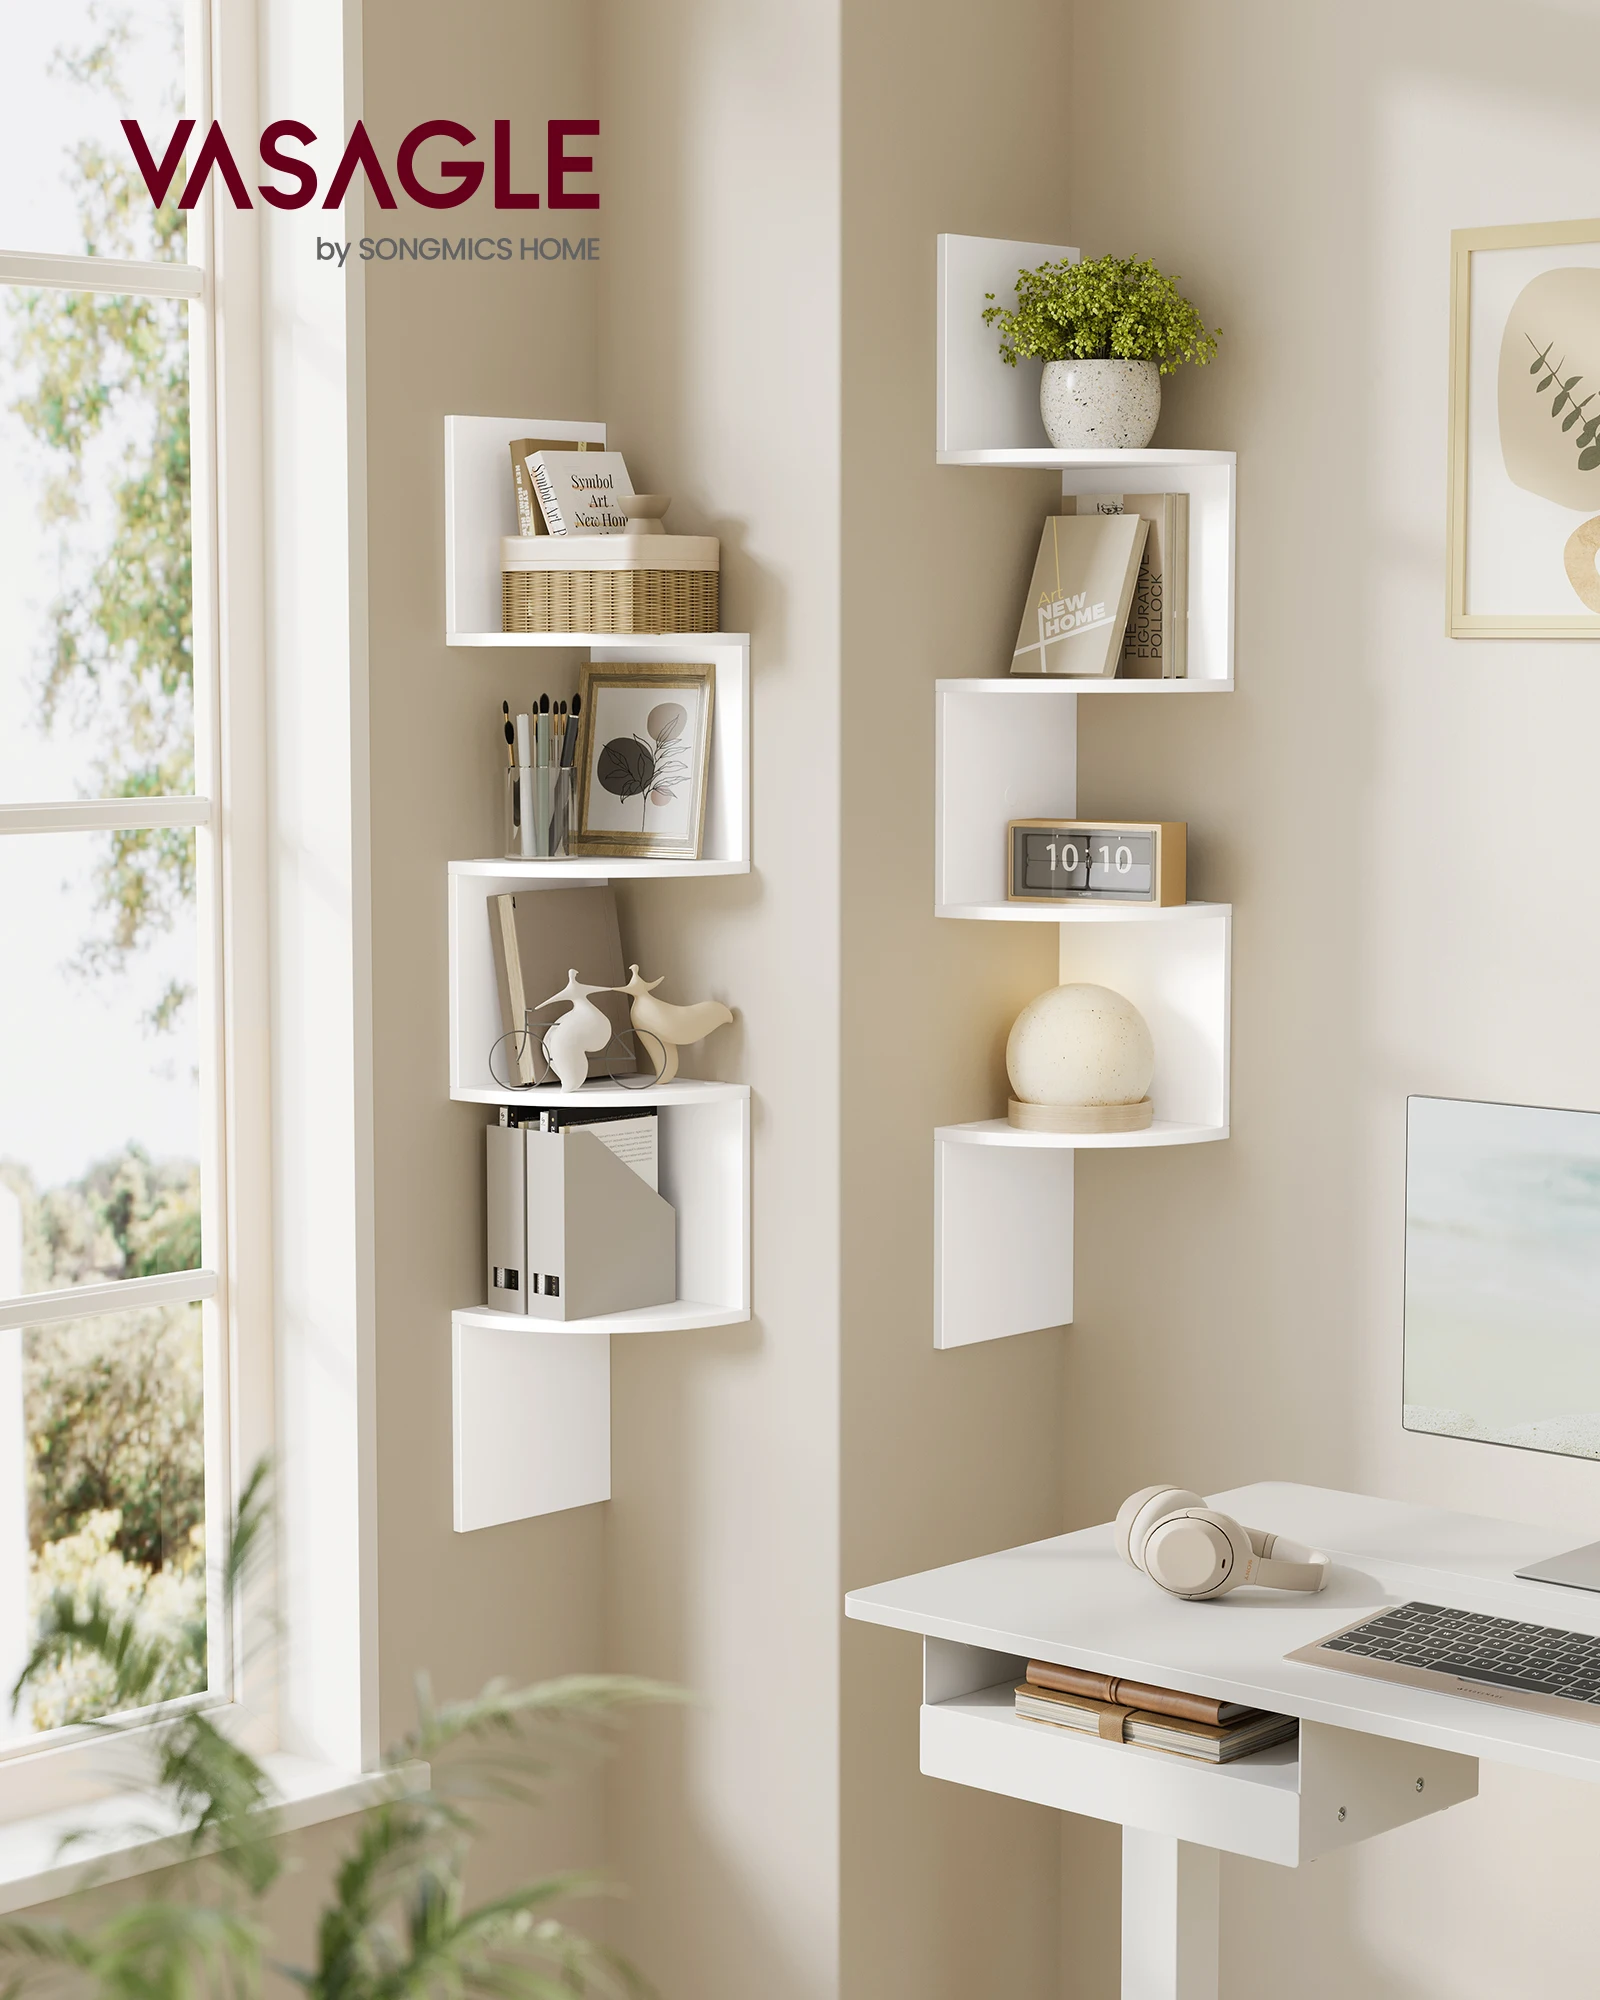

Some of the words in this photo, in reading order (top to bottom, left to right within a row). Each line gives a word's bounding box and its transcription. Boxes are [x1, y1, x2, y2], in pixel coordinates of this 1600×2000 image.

[531, 463, 557, 504] Symbol
[545, 507, 562, 524] Art
[570, 473, 614, 491] Symbol
[574, 511, 600, 528] New
[601, 512, 629, 527] Hom
[1037, 588, 1064, 608] Art
[1037, 591, 1087, 620] NEW
[1137, 554, 1150, 658] FIGURATIVE
[1045, 601, 1106, 637] HOME
[1150, 574, 1163, 659] POLLOCK
[1124, 623, 1137, 660] THE
[1045, 843, 1079, 872] 10
[1098, 845, 1133, 874] 10
